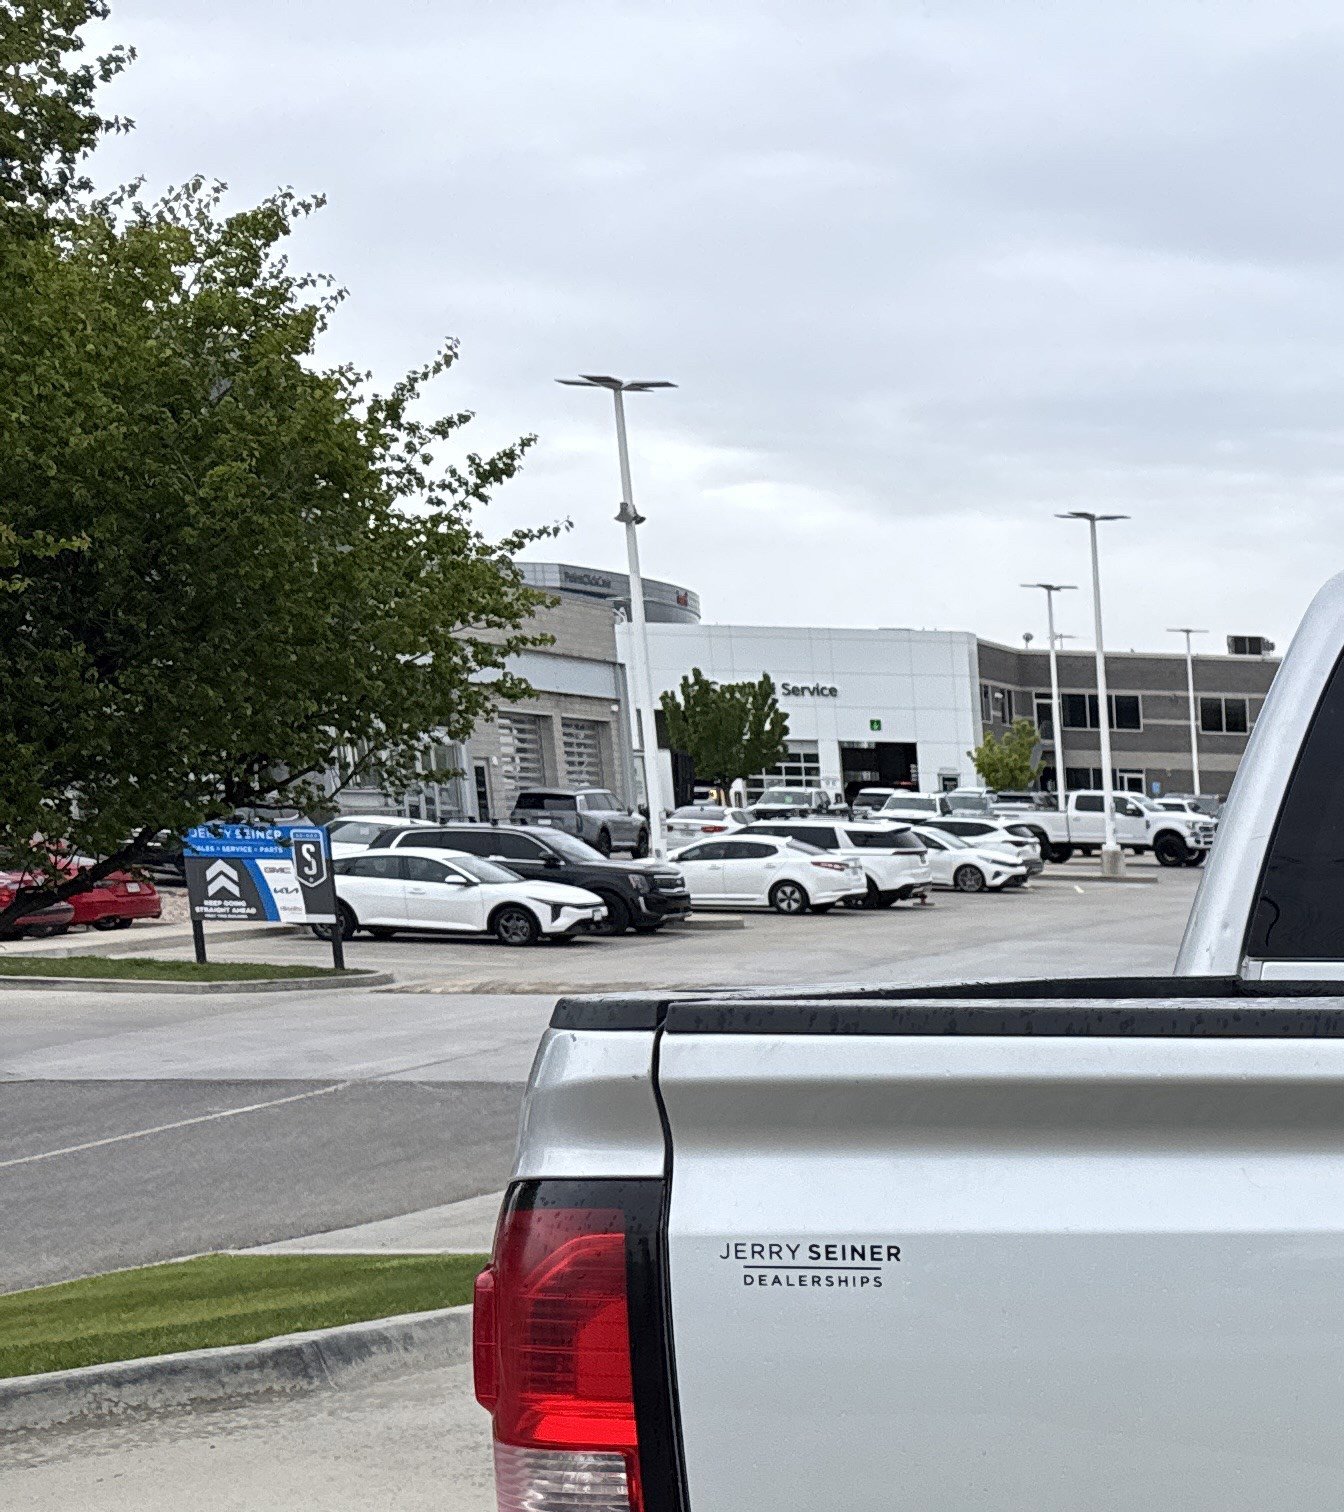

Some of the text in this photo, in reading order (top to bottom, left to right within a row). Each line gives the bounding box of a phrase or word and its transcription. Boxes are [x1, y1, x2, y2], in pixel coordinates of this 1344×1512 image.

[782, 683, 838, 697] Service
[720, 1243, 900, 1262] JERRY SEINER
[744, 1275, 882, 1288] DEALERSHIPS
